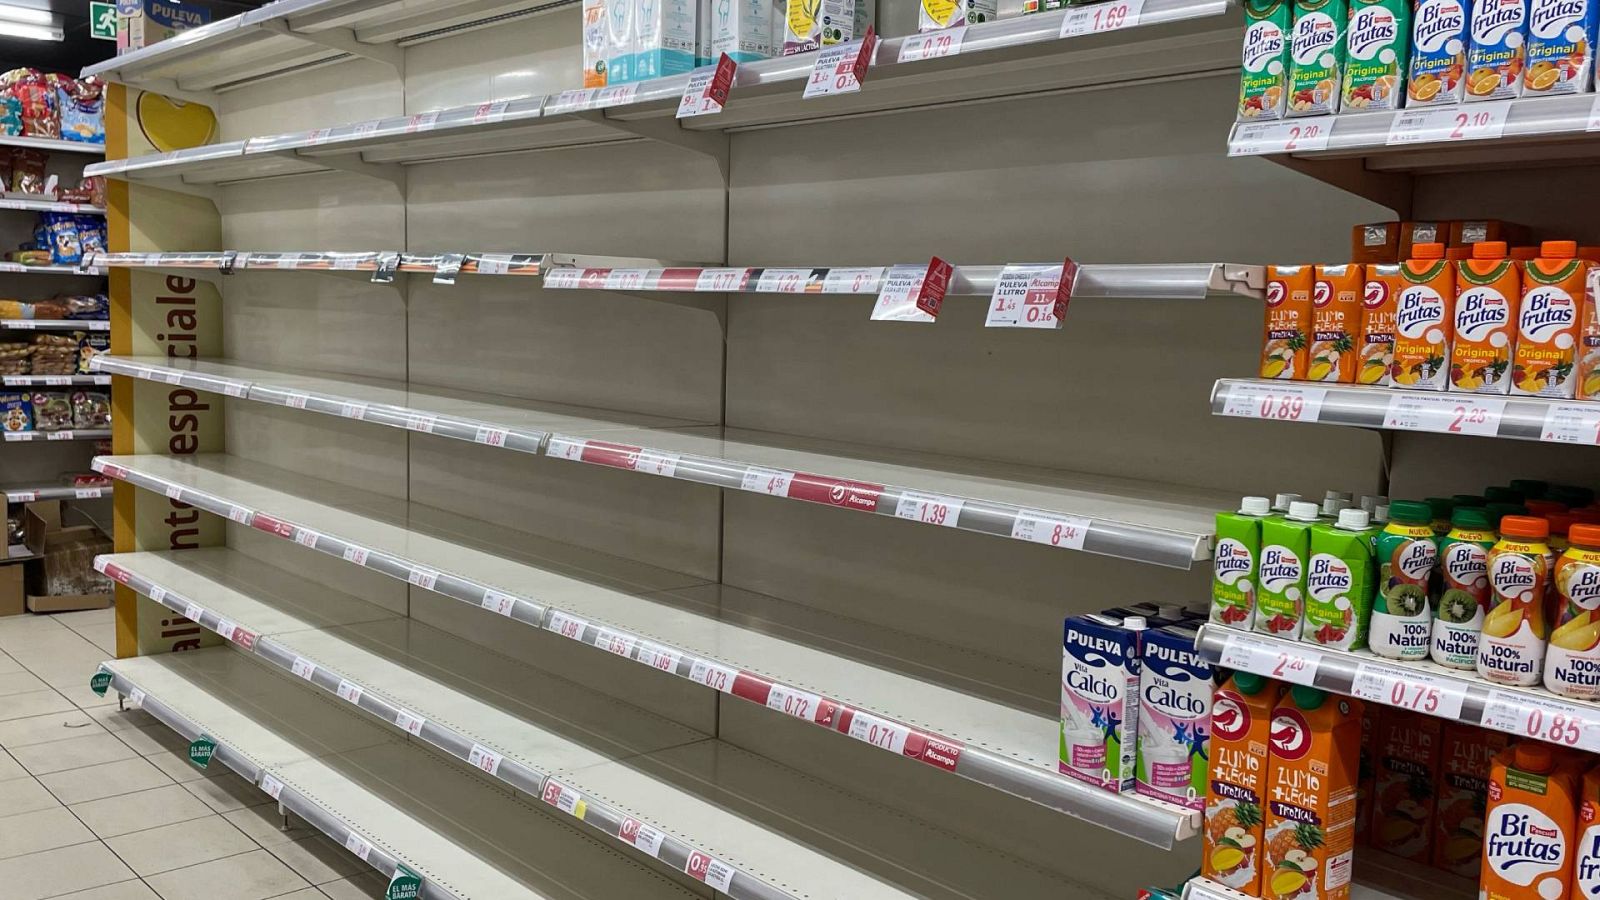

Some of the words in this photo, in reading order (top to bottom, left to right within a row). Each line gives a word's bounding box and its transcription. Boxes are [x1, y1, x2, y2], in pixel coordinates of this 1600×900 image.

[151, 2, 202, 24] PULEVA
[1093, 5, 1128, 29] 1.69
[1424, 2, 1440, 22] Bi
[1474, 7, 1522, 35] frutas
[1531, 0, 1584, 32] frutas
[1300, 18, 1316, 35] Bi
[1358, 12, 1374, 31] Bi
[1416, 15, 1461, 42] frutas
[1250, 27, 1264, 44] Bi
[1293, 30, 1334, 54] frutas
[1350, 25, 1394, 50] frutas
[922, 36, 952, 58] 0.79
[1243, 38, 1281, 63] frutas
[1528, 44, 1574, 57] Original
[1414, 56, 1454, 70] Original
[1470, 50, 1514, 63] Original
[1292, 69, 1328, 81] Original
[1347, 65, 1388, 78] Original
[1451, 112, 1489, 138] 2.10
[1285, 126, 1318, 150] 2.20
[713, 274, 736, 290] 0.77
[776, 274, 800, 292] 1.22
[1031, 279, 1060, 288] Alcamp
[1405, 292, 1422, 310] Bi
[1466, 293, 1484, 312] Bi
[1531, 293, 1548, 312] Bi
[1270, 310, 1298, 322] ZUMO
[1316, 311, 1344, 322] ZUMO
[1398, 306, 1441, 326] frutas
[1457, 308, 1505, 328] frutas
[1522, 308, 1572, 328] frutas
[1366, 324, 1396, 334] +LECH
[1396, 344, 1434, 356] Original
[1456, 348, 1499, 359] Original
[1518, 349, 1564, 360] Original
[1260, 394, 1304, 419] 0.89
[1448, 406, 1488, 432] 2.25
[849, 494, 876, 506] Alcampo
[920, 502, 948, 525] 1.39
[1051, 524, 1075, 545] 8.34
[1220, 544, 1234, 558] Bi
[1412, 545, 1426, 558] Bi
[1456, 548, 1472, 562] Bi
[1504, 544, 1530, 552] NUEVO
[1216, 556, 1250, 570] frutas
[1266, 551, 1282, 565] Bi
[1314, 560, 1330, 574] Bi
[1501, 560, 1515, 574] Bi
[1261, 564, 1299, 578] frutas
[1450, 561, 1488, 574] frutas
[1309, 572, 1349, 586] frutas
[1495, 573, 1534, 586] frutas
[1582, 571, 1598, 586] Bi
[1214, 587, 1245, 601] Original
[1571, 583, 1600, 598] frut
[1258, 594, 1294, 610] Original
[1306, 603, 1344, 620] Original
[1404, 624, 1427, 635] 100%
[1448, 630, 1476, 644] 100%
[1066, 629, 1122, 657] PULEVA
[1436, 638, 1478, 656] Natur
[1145, 642, 1210, 670] PULEVA
[1491, 645, 1520, 660] 100%
[1074, 662, 1088, 674] Vita
[1272, 652, 1304, 676] 2.20
[1480, 652, 1534, 674] Natural
[706, 668, 727, 690] 0.73
[1067, 670, 1118, 700] Calcio
[1153, 677, 1169, 688] Vita
[1487, 672, 1520, 682] TROPICAL
[1555, 666, 1600, 686] Natur
[1145, 685, 1204, 714] Calcio
[1391, 680, 1440, 712] 0.75
[784, 695, 809, 718] 0.72
[1527, 708, 1582, 745] 0.85
[869, 724, 896, 749] 0.71
[1390, 726, 1432, 747] ZUMO
[199, 744, 211, 752] MÁS
[926, 748, 955, 766] Alcampo
[928, 740, 959, 756] PRODUCTO
[1218, 747, 1260, 771] ZUMO
[1212, 766, 1257, 790] +LECHE
[1278, 766, 1320, 791] ZUMO
[1219, 783, 1253, 802] TROPICAL
[1272, 786, 1318, 810] +LECHE
[1278, 803, 1314, 823] TROPICAL
[1500, 814, 1528, 837] Bi
[1532, 826, 1556, 837] Pascual
[1488, 833, 1560, 861] frutas
[392, 890, 416, 900] BARATO
[401, 883, 416, 892] MÁS
